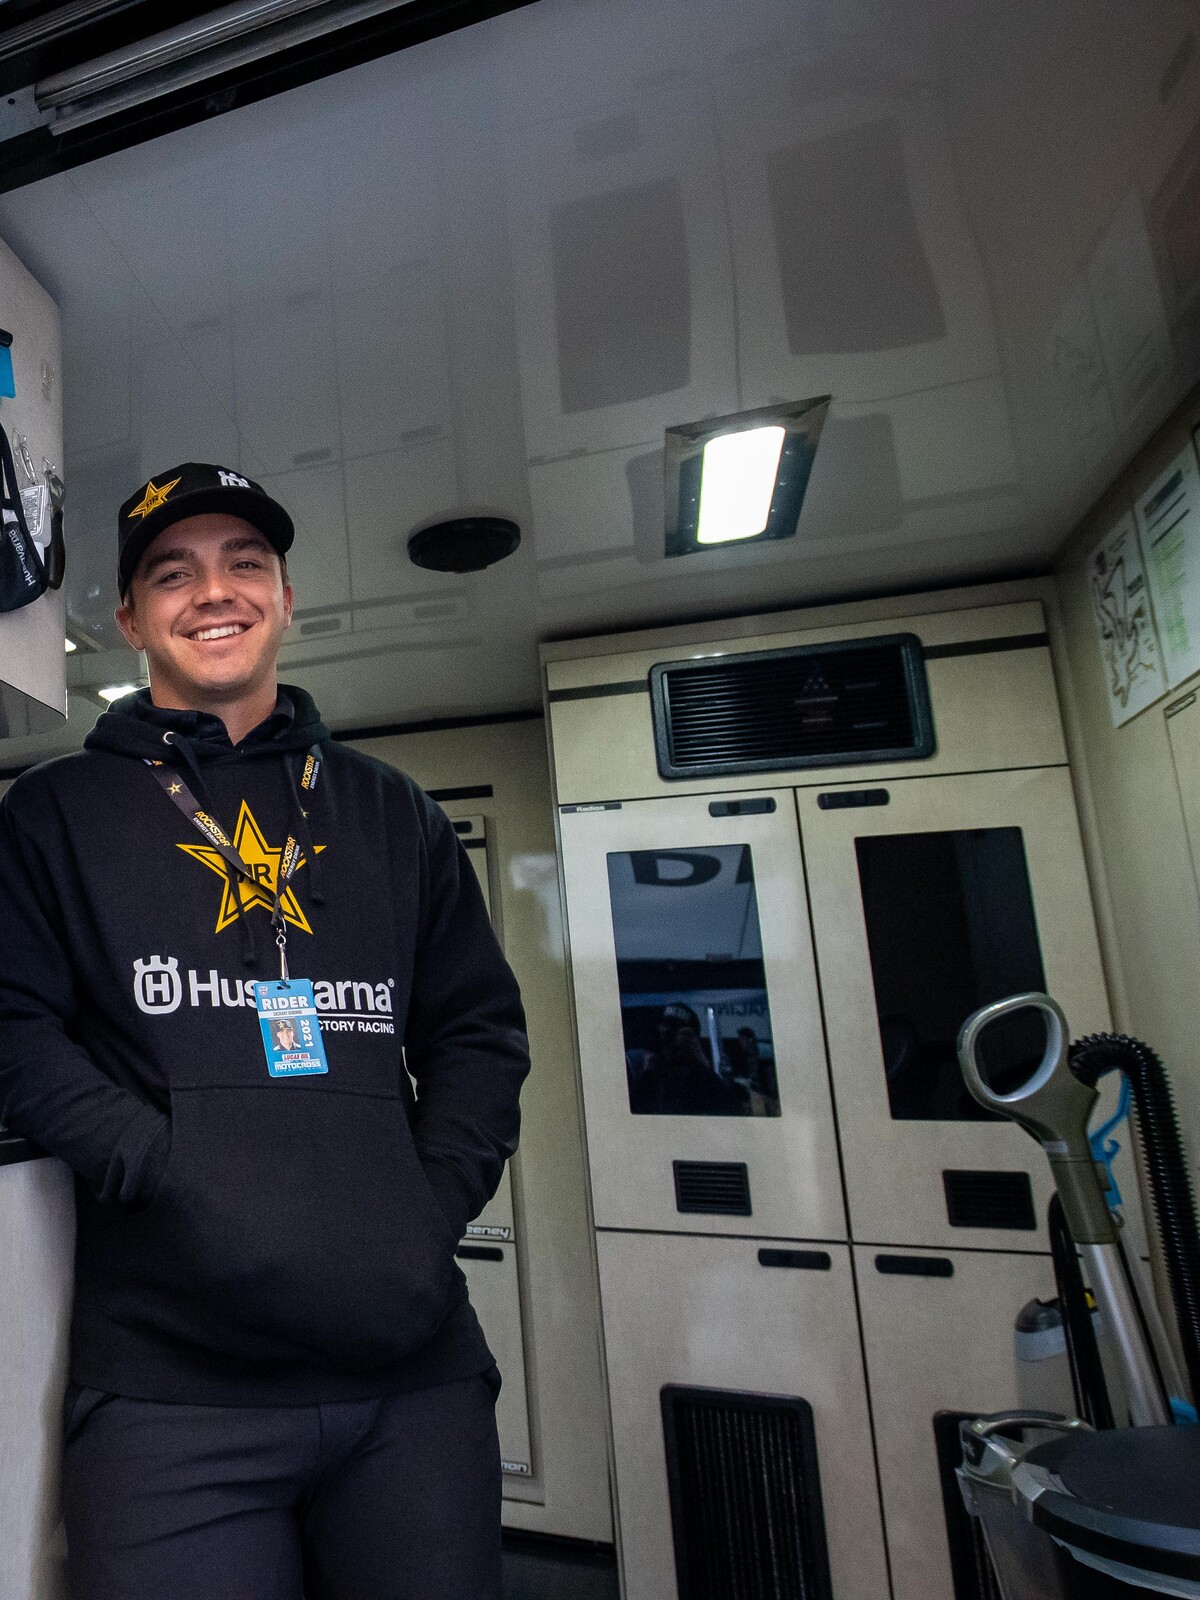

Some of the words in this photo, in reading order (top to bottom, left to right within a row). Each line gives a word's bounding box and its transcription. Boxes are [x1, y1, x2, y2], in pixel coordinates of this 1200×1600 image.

[301, 754, 315, 789] ROCKSTAR
[193, 817, 211, 836] ENERGY
[194, 810, 231, 847] ROCKSTAR
[280, 835, 296, 878] ROCKSTAR
[286, 860, 297, 879] ENERGY
[188, 969, 392, 1012] Husarna
[261, 995, 309, 1010] RIDER
[300, 1019, 314, 1047] 2021
[318, 1019, 355, 1032] CTORY
[357, 1021, 394, 1034] RACING
[274, 1060, 321, 1070] MOTOCROSS
[467, 1225, 510, 1239] eeney
